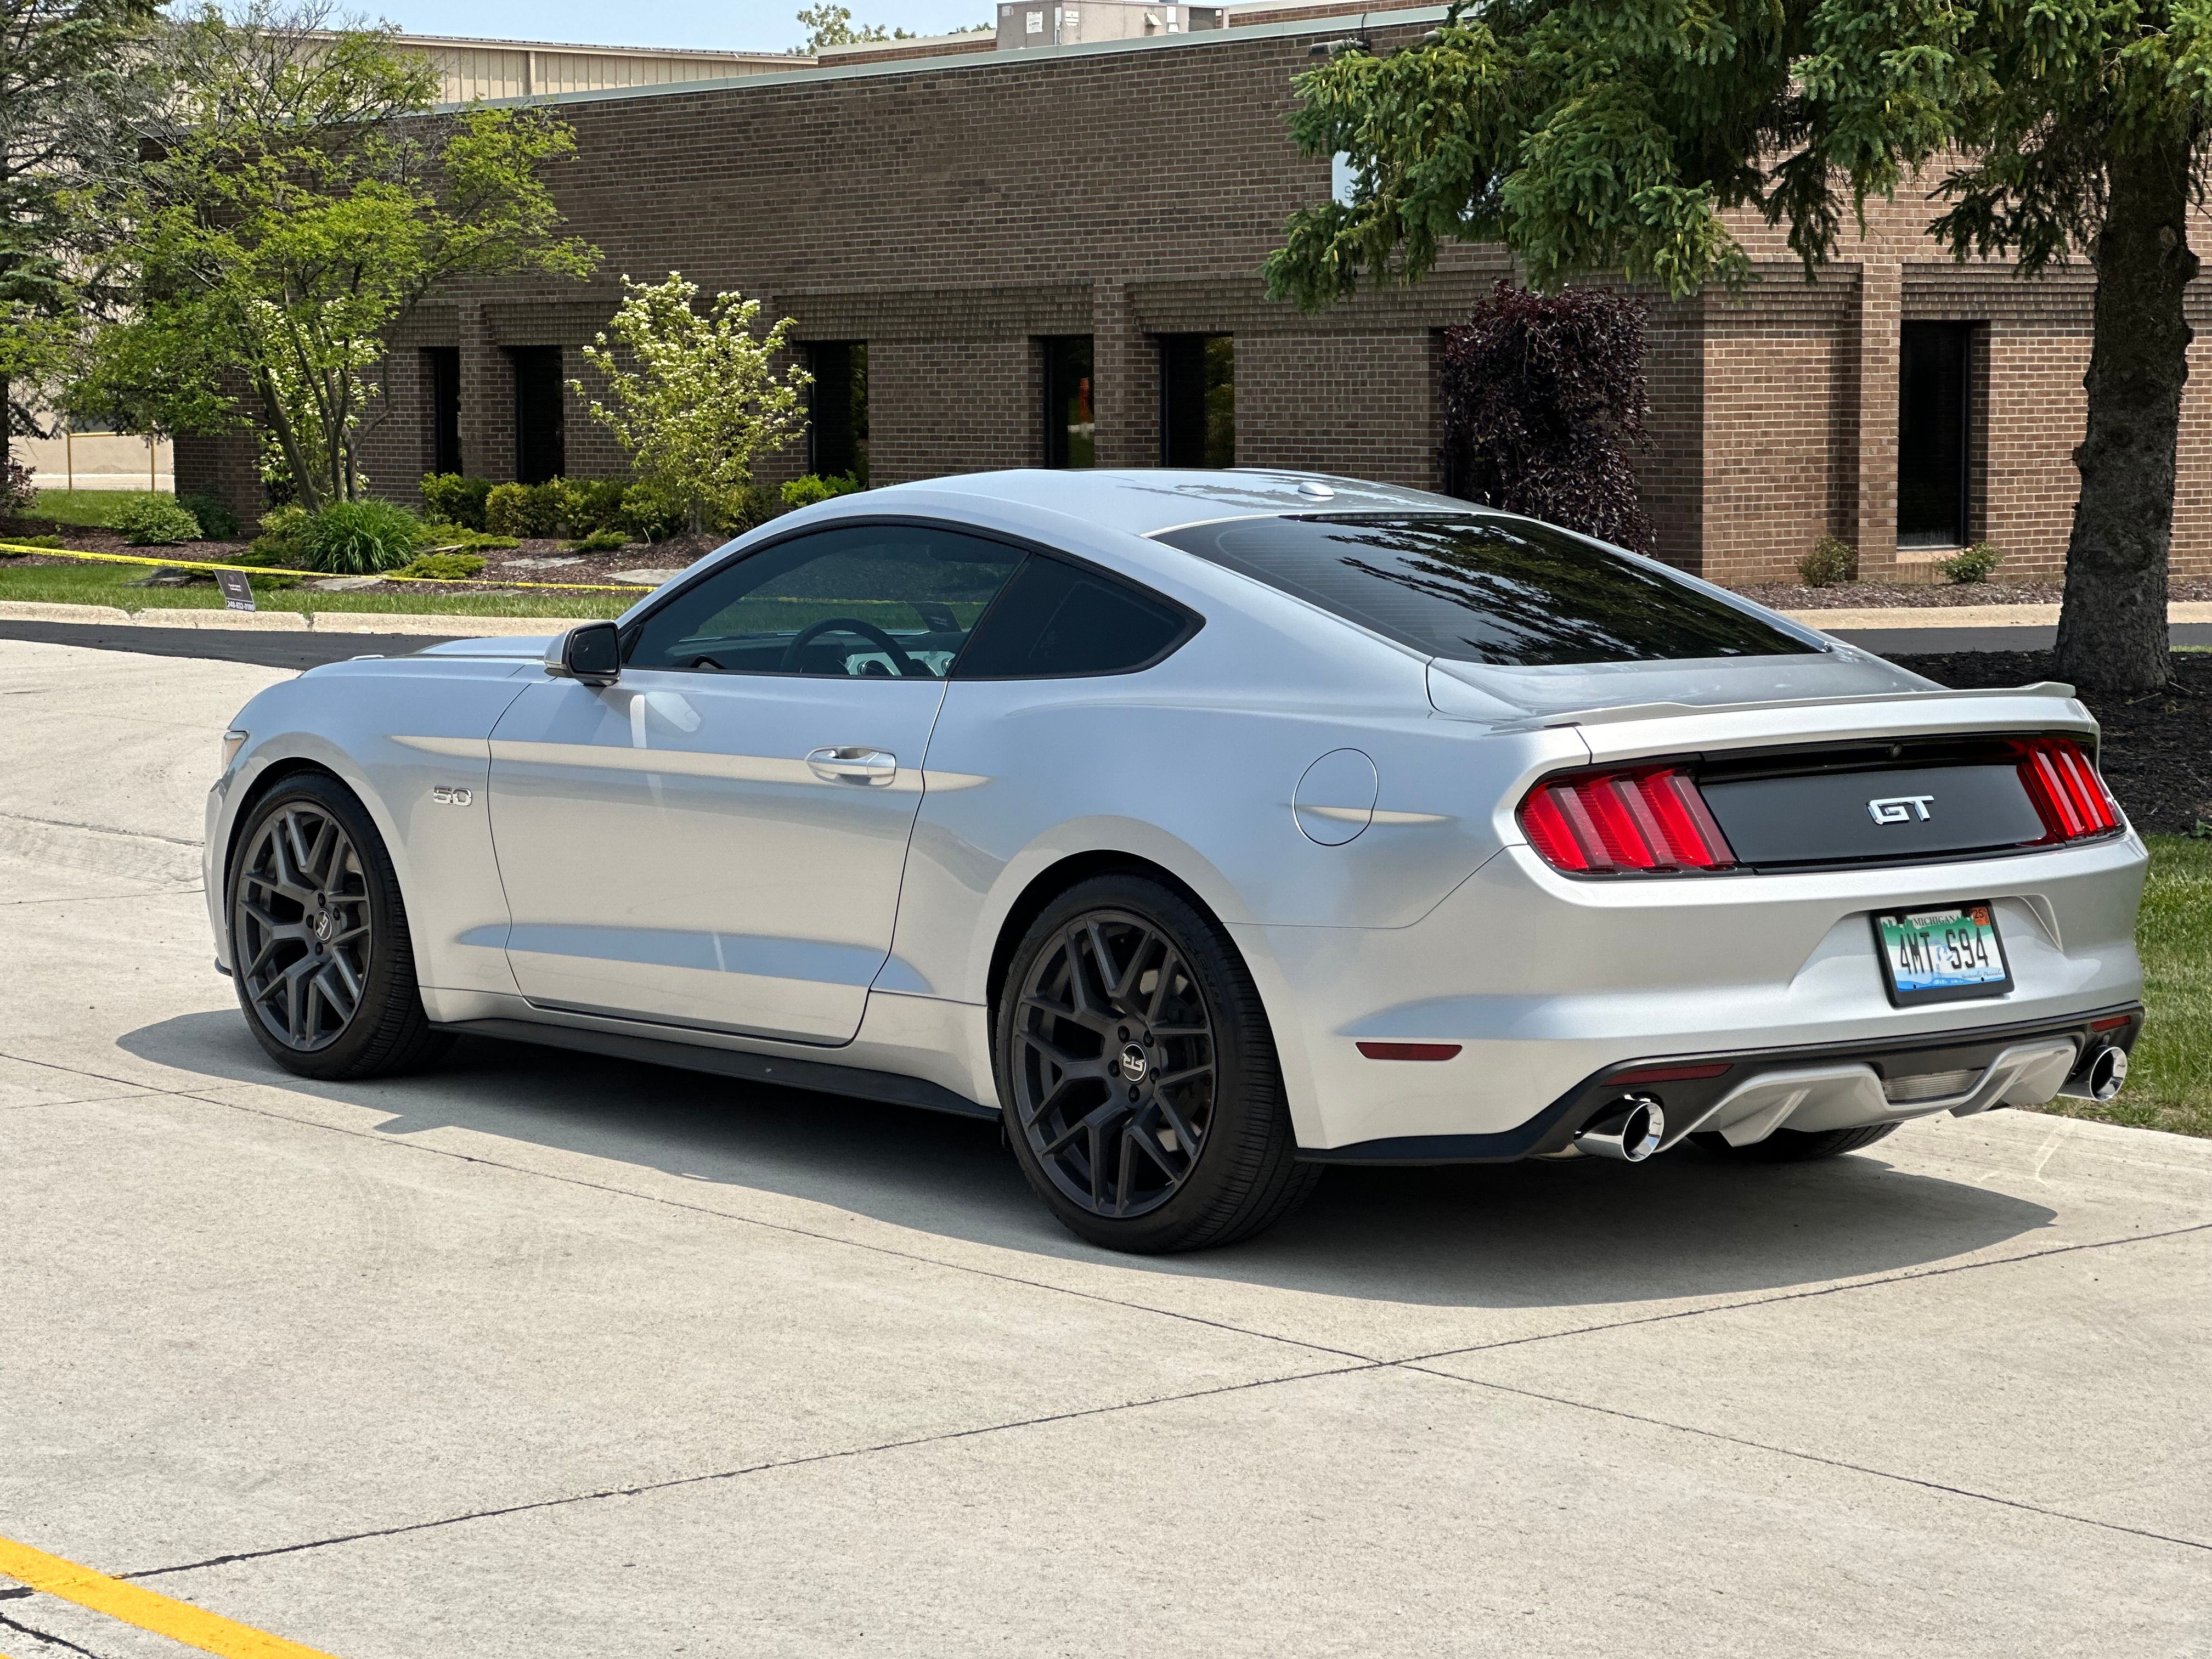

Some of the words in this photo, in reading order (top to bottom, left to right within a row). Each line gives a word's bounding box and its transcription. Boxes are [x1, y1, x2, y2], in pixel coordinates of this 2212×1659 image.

[1866, 795, 1935, 825] GT
[1913, 915, 1956, 927] MICHIGAN
[1900, 932, 1934, 974] 4MT
